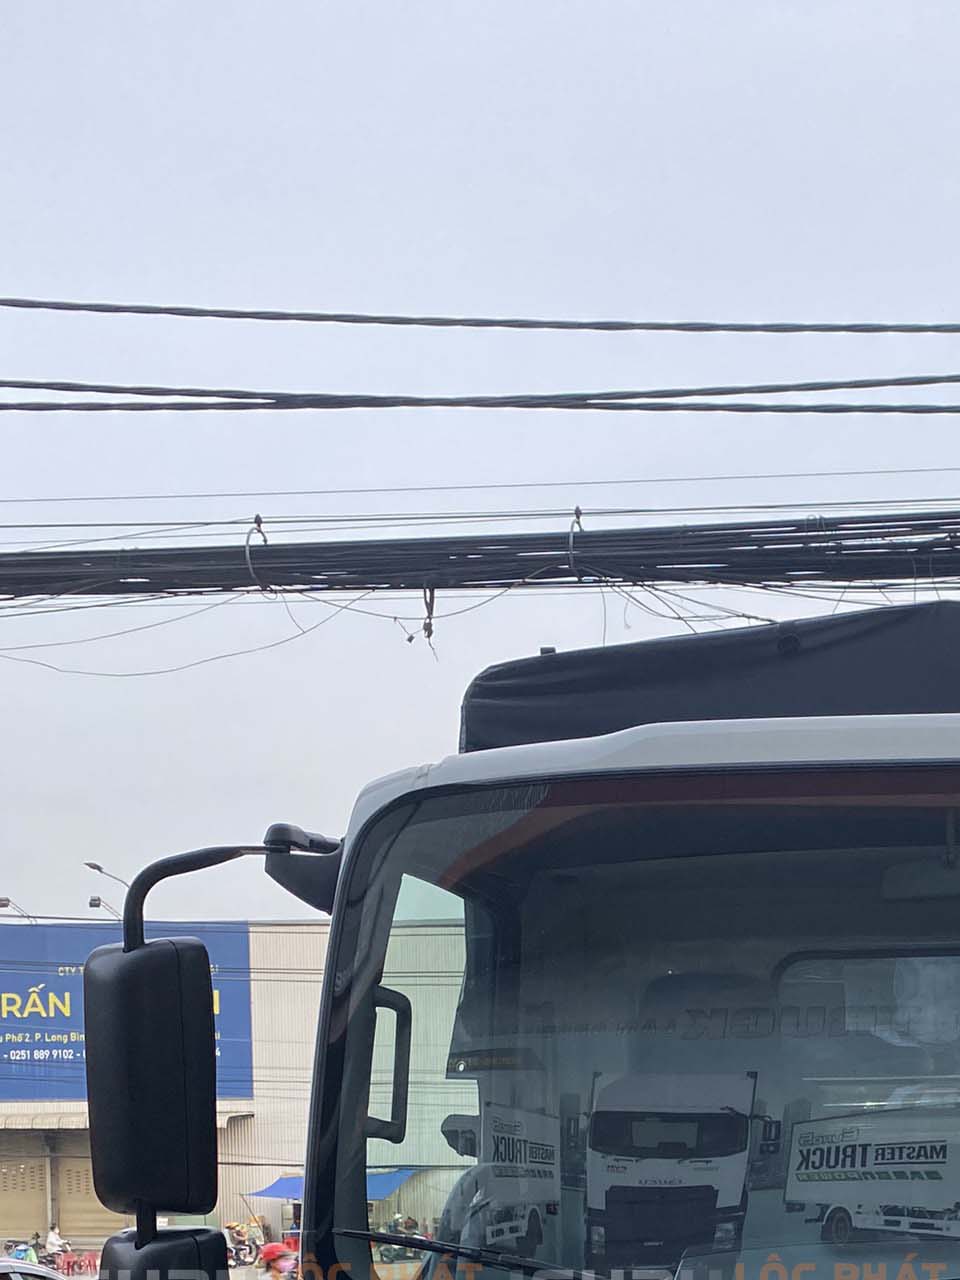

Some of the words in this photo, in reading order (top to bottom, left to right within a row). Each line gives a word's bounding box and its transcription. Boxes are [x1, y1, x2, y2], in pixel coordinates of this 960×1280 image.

[1, 984, 71, 1018] RẤN
[45, 1032, 68, 1044] Long
[10, 1050, 30, 1060] 0251
[33, 1050, 50, 1060] 889
[52, 1049, 74, 1059] 9102
